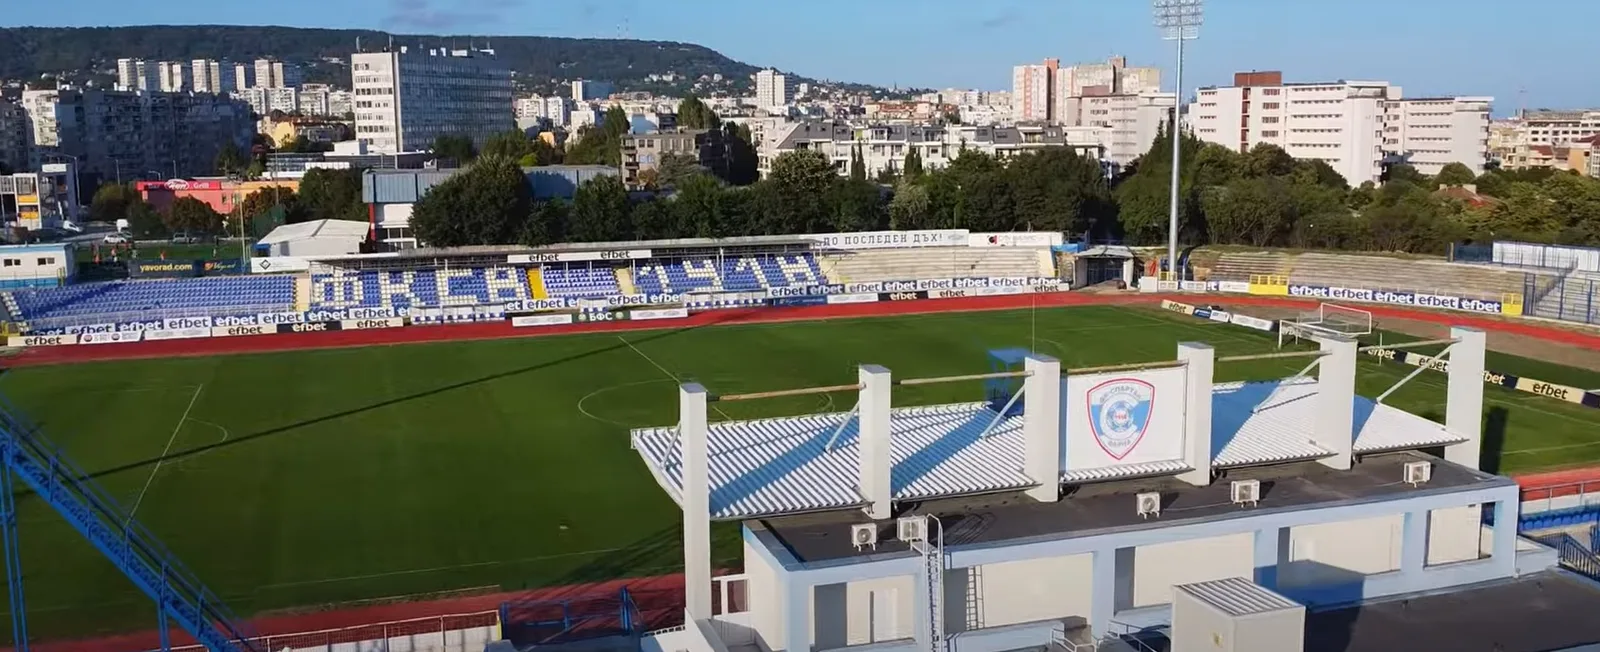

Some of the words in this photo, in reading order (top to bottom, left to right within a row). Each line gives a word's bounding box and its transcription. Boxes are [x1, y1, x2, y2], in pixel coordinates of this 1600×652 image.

[845, 234, 907, 245] ПОСЛЕДЕН
[913, 232, 943, 243] ДЪХ!
[529, 253, 559, 262] efbet
[600, 250, 630, 260] efbet
[139, 263, 192, 273] yavorad.com
[849, 283, 880, 292] efbet
[884, 280, 916, 291] efbet
[921, 279, 950, 289] efbet
[955, 278, 987, 287] efbet
[992, 277, 1024, 287] efbet
[772, 286, 804, 297] efbet
[809, 284, 843, 294] efbet
[939, 289, 965, 297] efbet
[1034, 284, 1058, 292] efbet
[1290, 285, 1328, 297] efbet
[609, 294, 644, 305] efbet
[890, 292, 917, 300] efbet
[1333, 288, 1370, 300] efbet
[1375, 291, 1413, 304] efbet
[527, 299, 562, 310] efbet
[1418, 295, 1456, 308] efbet
[1461, 299, 1500, 312] efbet
[354, 307, 390, 318] efbet
[1168, 302, 1187, 313] efbet
[215, 315, 257, 325] efbet
[263, 313, 301, 324] efbet
[308, 310, 348, 321] efbet
[589, 312, 613, 321] БФС
[119, 320, 162, 331] efbet
[169, 318, 208, 329] efbet
[292, 322, 327, 332] efbet
[356, 319, 389, 328] efbet
[228, 325, 263, 335] efbet
[25, 336, 62, 346] efbet
[1532, 382, 1568, 399] efbet
